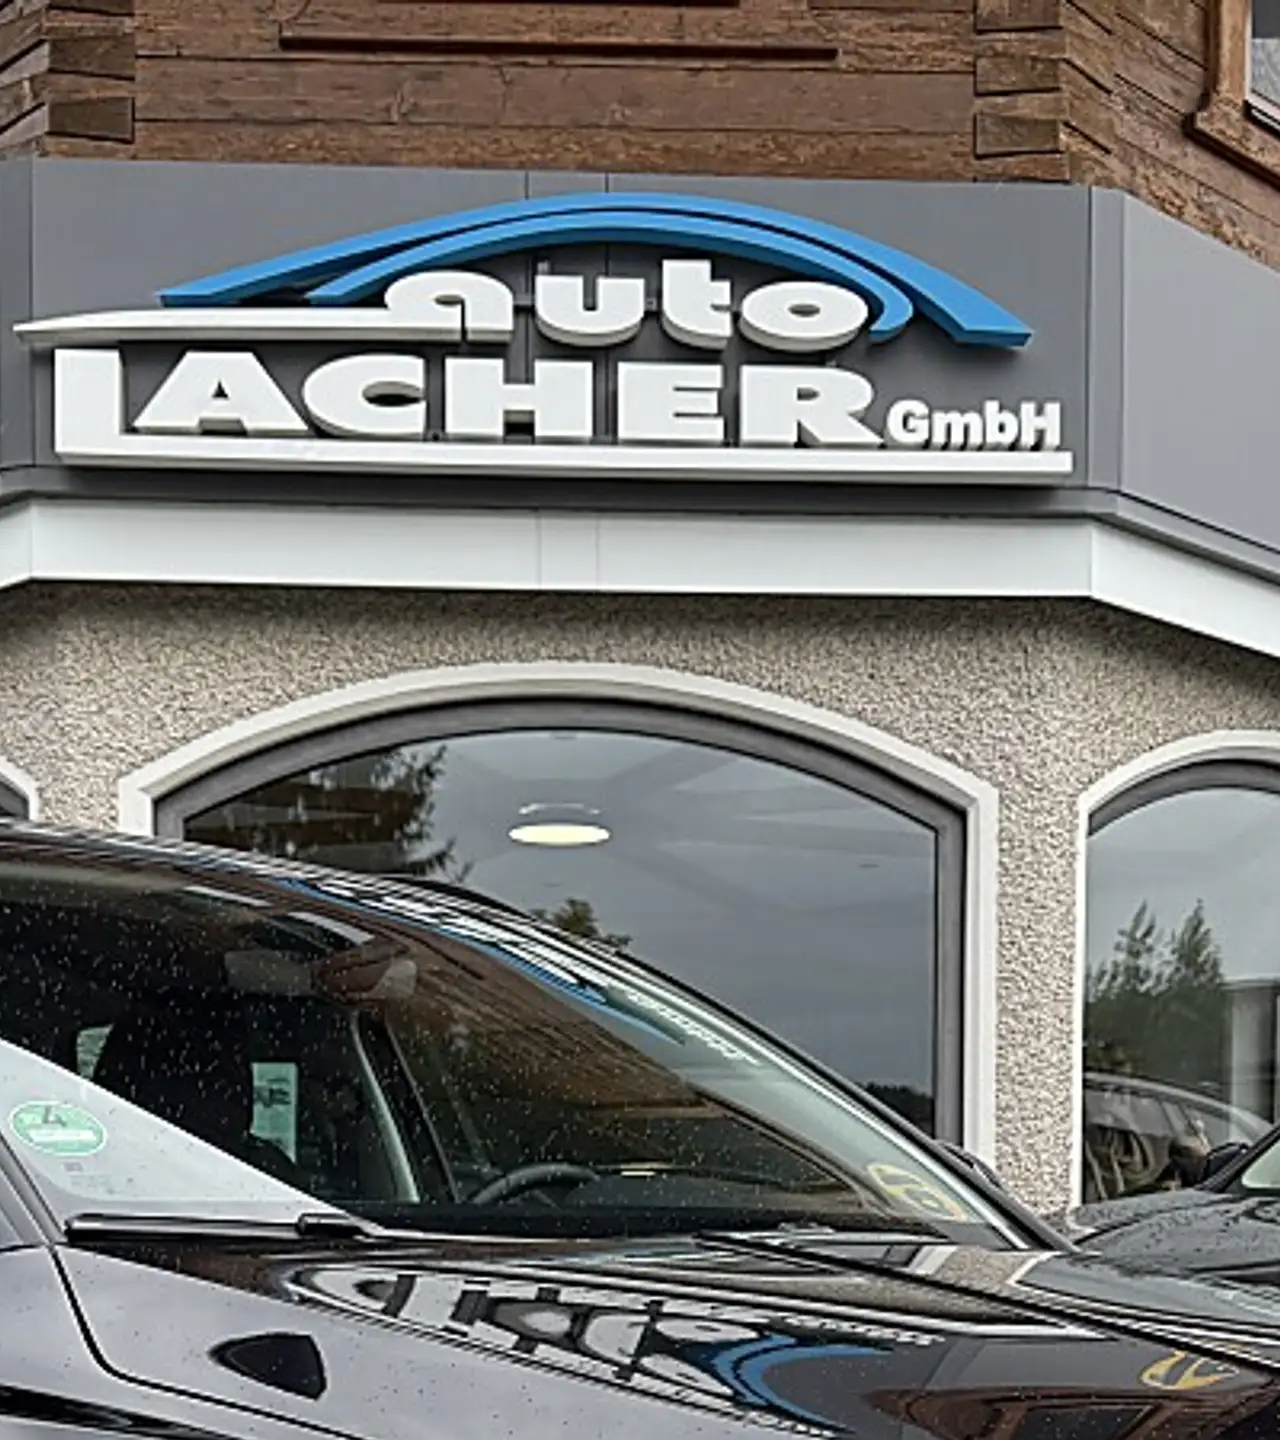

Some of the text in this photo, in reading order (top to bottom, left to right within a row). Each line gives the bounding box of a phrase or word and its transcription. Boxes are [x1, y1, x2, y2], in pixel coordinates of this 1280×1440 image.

[383, 258, 869, 352] auto
[53, 346, 1064, 472] LACHER GmbH
